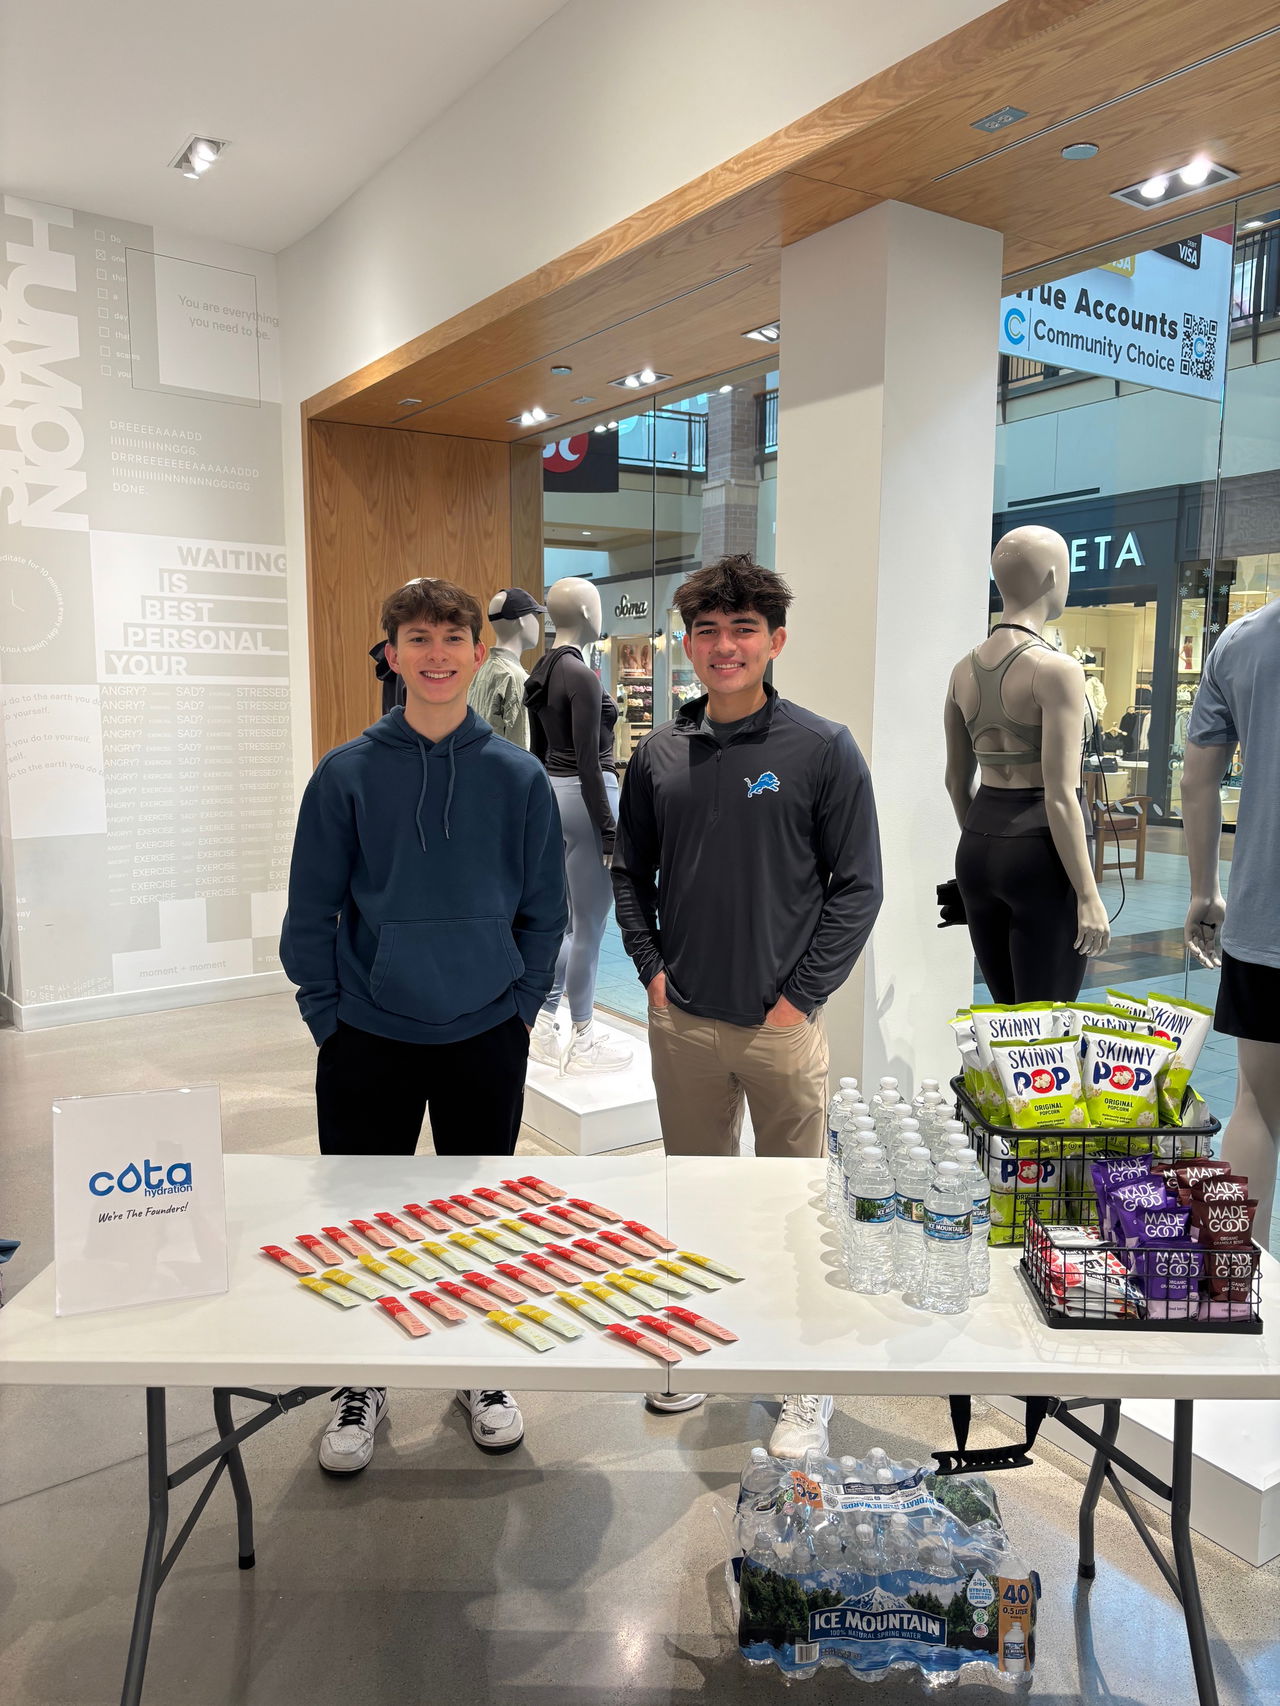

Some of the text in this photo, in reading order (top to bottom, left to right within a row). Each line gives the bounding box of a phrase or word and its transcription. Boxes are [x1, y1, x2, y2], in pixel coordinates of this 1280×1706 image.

[1178, 243, 1198, 265] VISA
[177, 294, 280, 329] You are everything
[1074, 288, 1178, 340] Accounts
[189, 317, 210, 329] you
[212, 320, 239, 335] need
[241, 326, 253, 338] to
[1033, 318, 1123, 364] Community
[1126, 342, 1175, 373] Choice
[177, 545, 288, 573] WAITING
[161, 572, 188, 593] IS
[145, 599, 214, 621] BEST
[614, 594, 649, 619] Soma
[128, 627, 271, 650] PERSONAL
[110, 655, 188, 676] YOUR
[101, 686, 147, 696] ANGRY?
[175, 686, 205, 697] SAD?
[101, 700, 145, 711] ANGRY?
[176, 700, 204, 711] SAD?
[102, 714, 290, 725] ANGRY? SAD? STRESSED?
[103, 728, 288, 739] ANGRY? SAD? STRESSED?
[103, 742, 286, 753] ANGRY? SAD? STRESSED?
[134, 854, 177, 864] EXERCISE
[132, 862, 238, 878] EXERCISE EXERCISE
[131, 875, 238, 892] EXERCISE EXERCISE
[129, 892, 177, 905] EXERCISE
[140, 966, 179, 978] moment
[189, 960, 227, 972] moment
[1013, 1067, 1071, 1096] POP
[1093, 1061, 1153, 1091] POP
[1034, 1102, 1064, 1112] ORIGINAL
[1104, 1098, 1134, 1108] ORIGINAL
[1001, 1159, 1055, 1184] POP
[1107, 1157, 1144, 1174] MADE
[144, 1184, 193, 1198] hydration
[1118, 1182, 1158, 1201] MADE
[1202, 1181, 1242, 1194] MADE
[98, 1201, 189, 1223] We're The Founders!
[1123, 1195, 1163, 1212] GOOD
[1144, 1212, 1185, 1226] MADE
[1208, 1205, 1249, 1220] MADE
[1145, 1224, 1185, 1238] GOOD
[1209, 1218, 1250, 1233] GOOD
[1156, 1252, 1199, 1265] MADE
[1215, 1253, 1252, 1266] MADE
[1156, 1263, 1199, 1277] GOOD
[1003, 1584, 1030, 1604] 40
[1002, 1607, 1014, 1615] 0.5
[814, 1611, 940, 1636] ICE MOUNTAIN
[848, 1630, 875, 1639] NATURAL
[877, 1630, 899, 1639] SPRING
[901, 1631, 921, 1639] WATER
